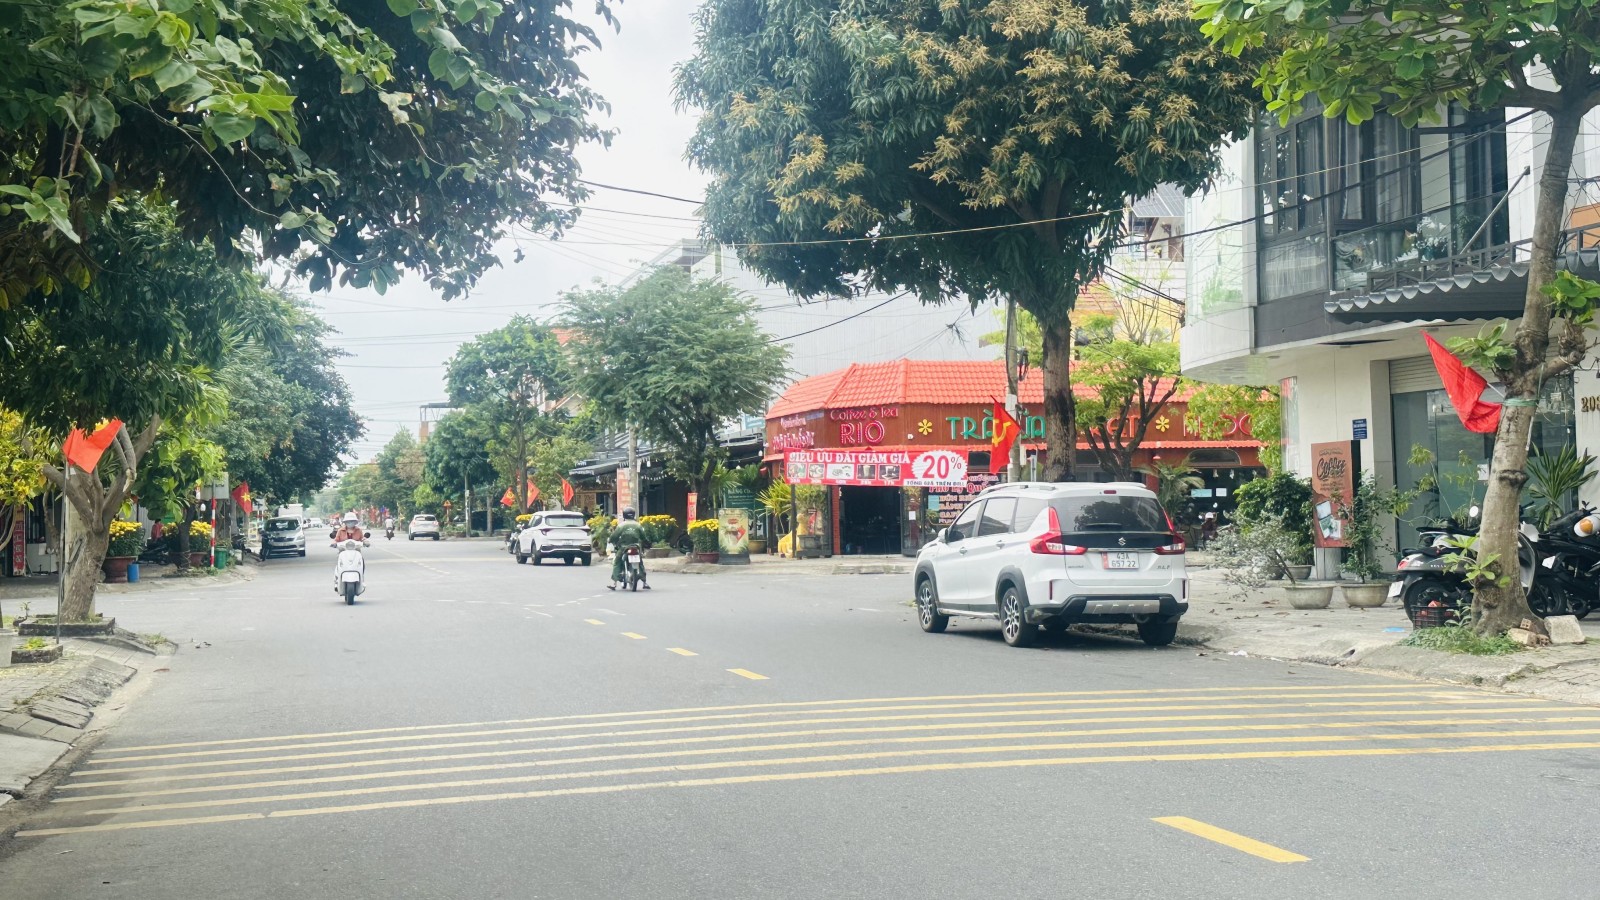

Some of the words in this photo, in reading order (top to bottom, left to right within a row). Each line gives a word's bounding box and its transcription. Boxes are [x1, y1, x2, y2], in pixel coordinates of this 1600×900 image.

[830, 409, 866, 421] Coffee
[881, 406, 899, 418] Tea
[840, 420, 885, 444] RIO
[789, 450, 814, 463] SIÊU
[890, 450, 911, 464] GIÁ
